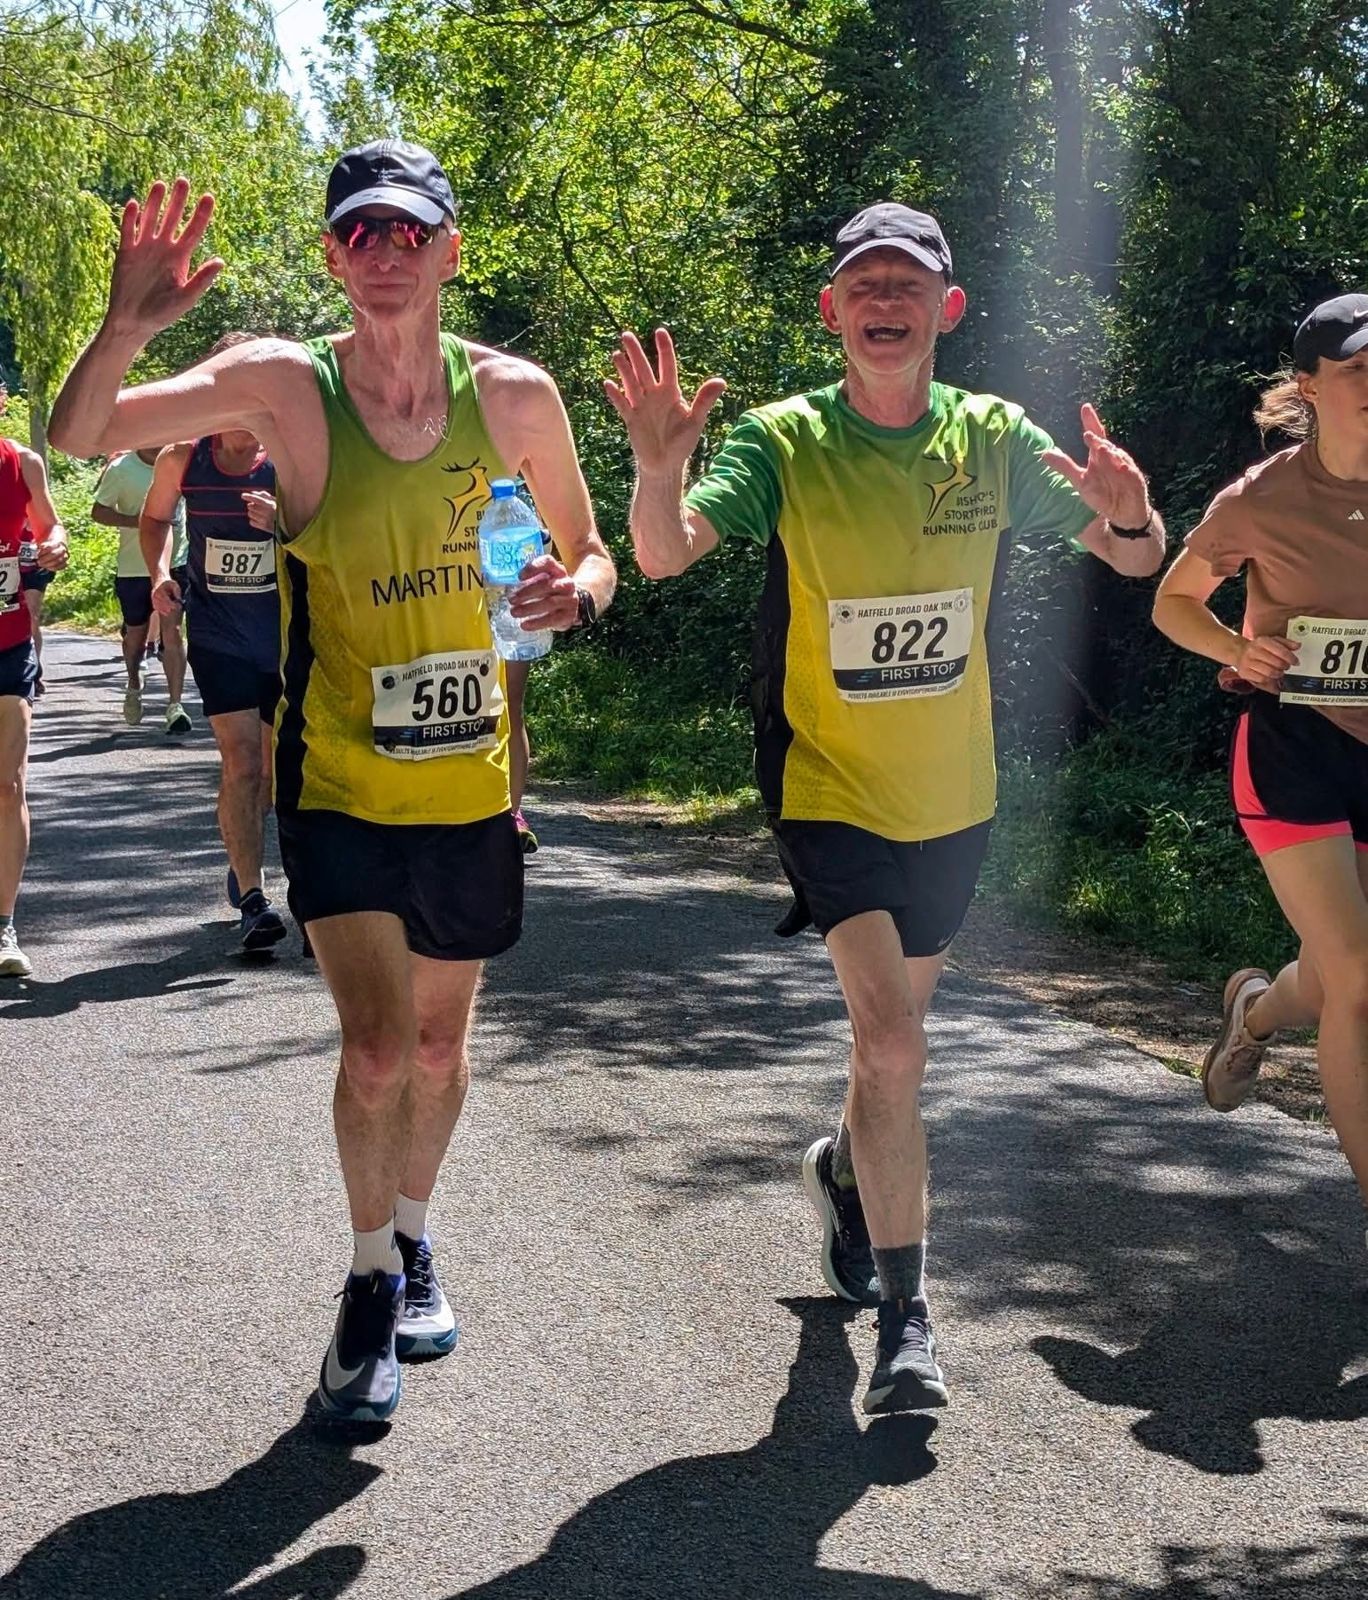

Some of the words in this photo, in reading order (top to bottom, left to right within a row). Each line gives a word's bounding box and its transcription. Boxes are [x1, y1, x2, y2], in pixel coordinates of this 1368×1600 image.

[923, 523, 976, 536] RUNNING
[978, 519, 998, 531] CUB
[221, 552, 262, 574] 987
[371, 564, 484, 607] MARTIN
[857, 607, 894, 619] HATFIELD
[895, 604, 921, 616] BROAD
[923, 603, 939, 613] OAK
[941, 601, 953, 611] 10K
[871, 616, 949, 664] 822
[1311, 626, 1343, 635] HATFIELD
[1344, 628, 1367, 636] BROAD
[402, 665, 433, 681] HATFIELD
[435, 661, 457, 673] BROAD
[458, 660, 470, 669] OAK
[470, 659, 481, 668] 10K
[881, 667, 920, 681] FIRST
[922, 662, 956, 677] STOP
[1323, 679, 1356, 689] FIRST
[412, 674, 482, 721] 560
[423, 723, 458, 739] FIRST
